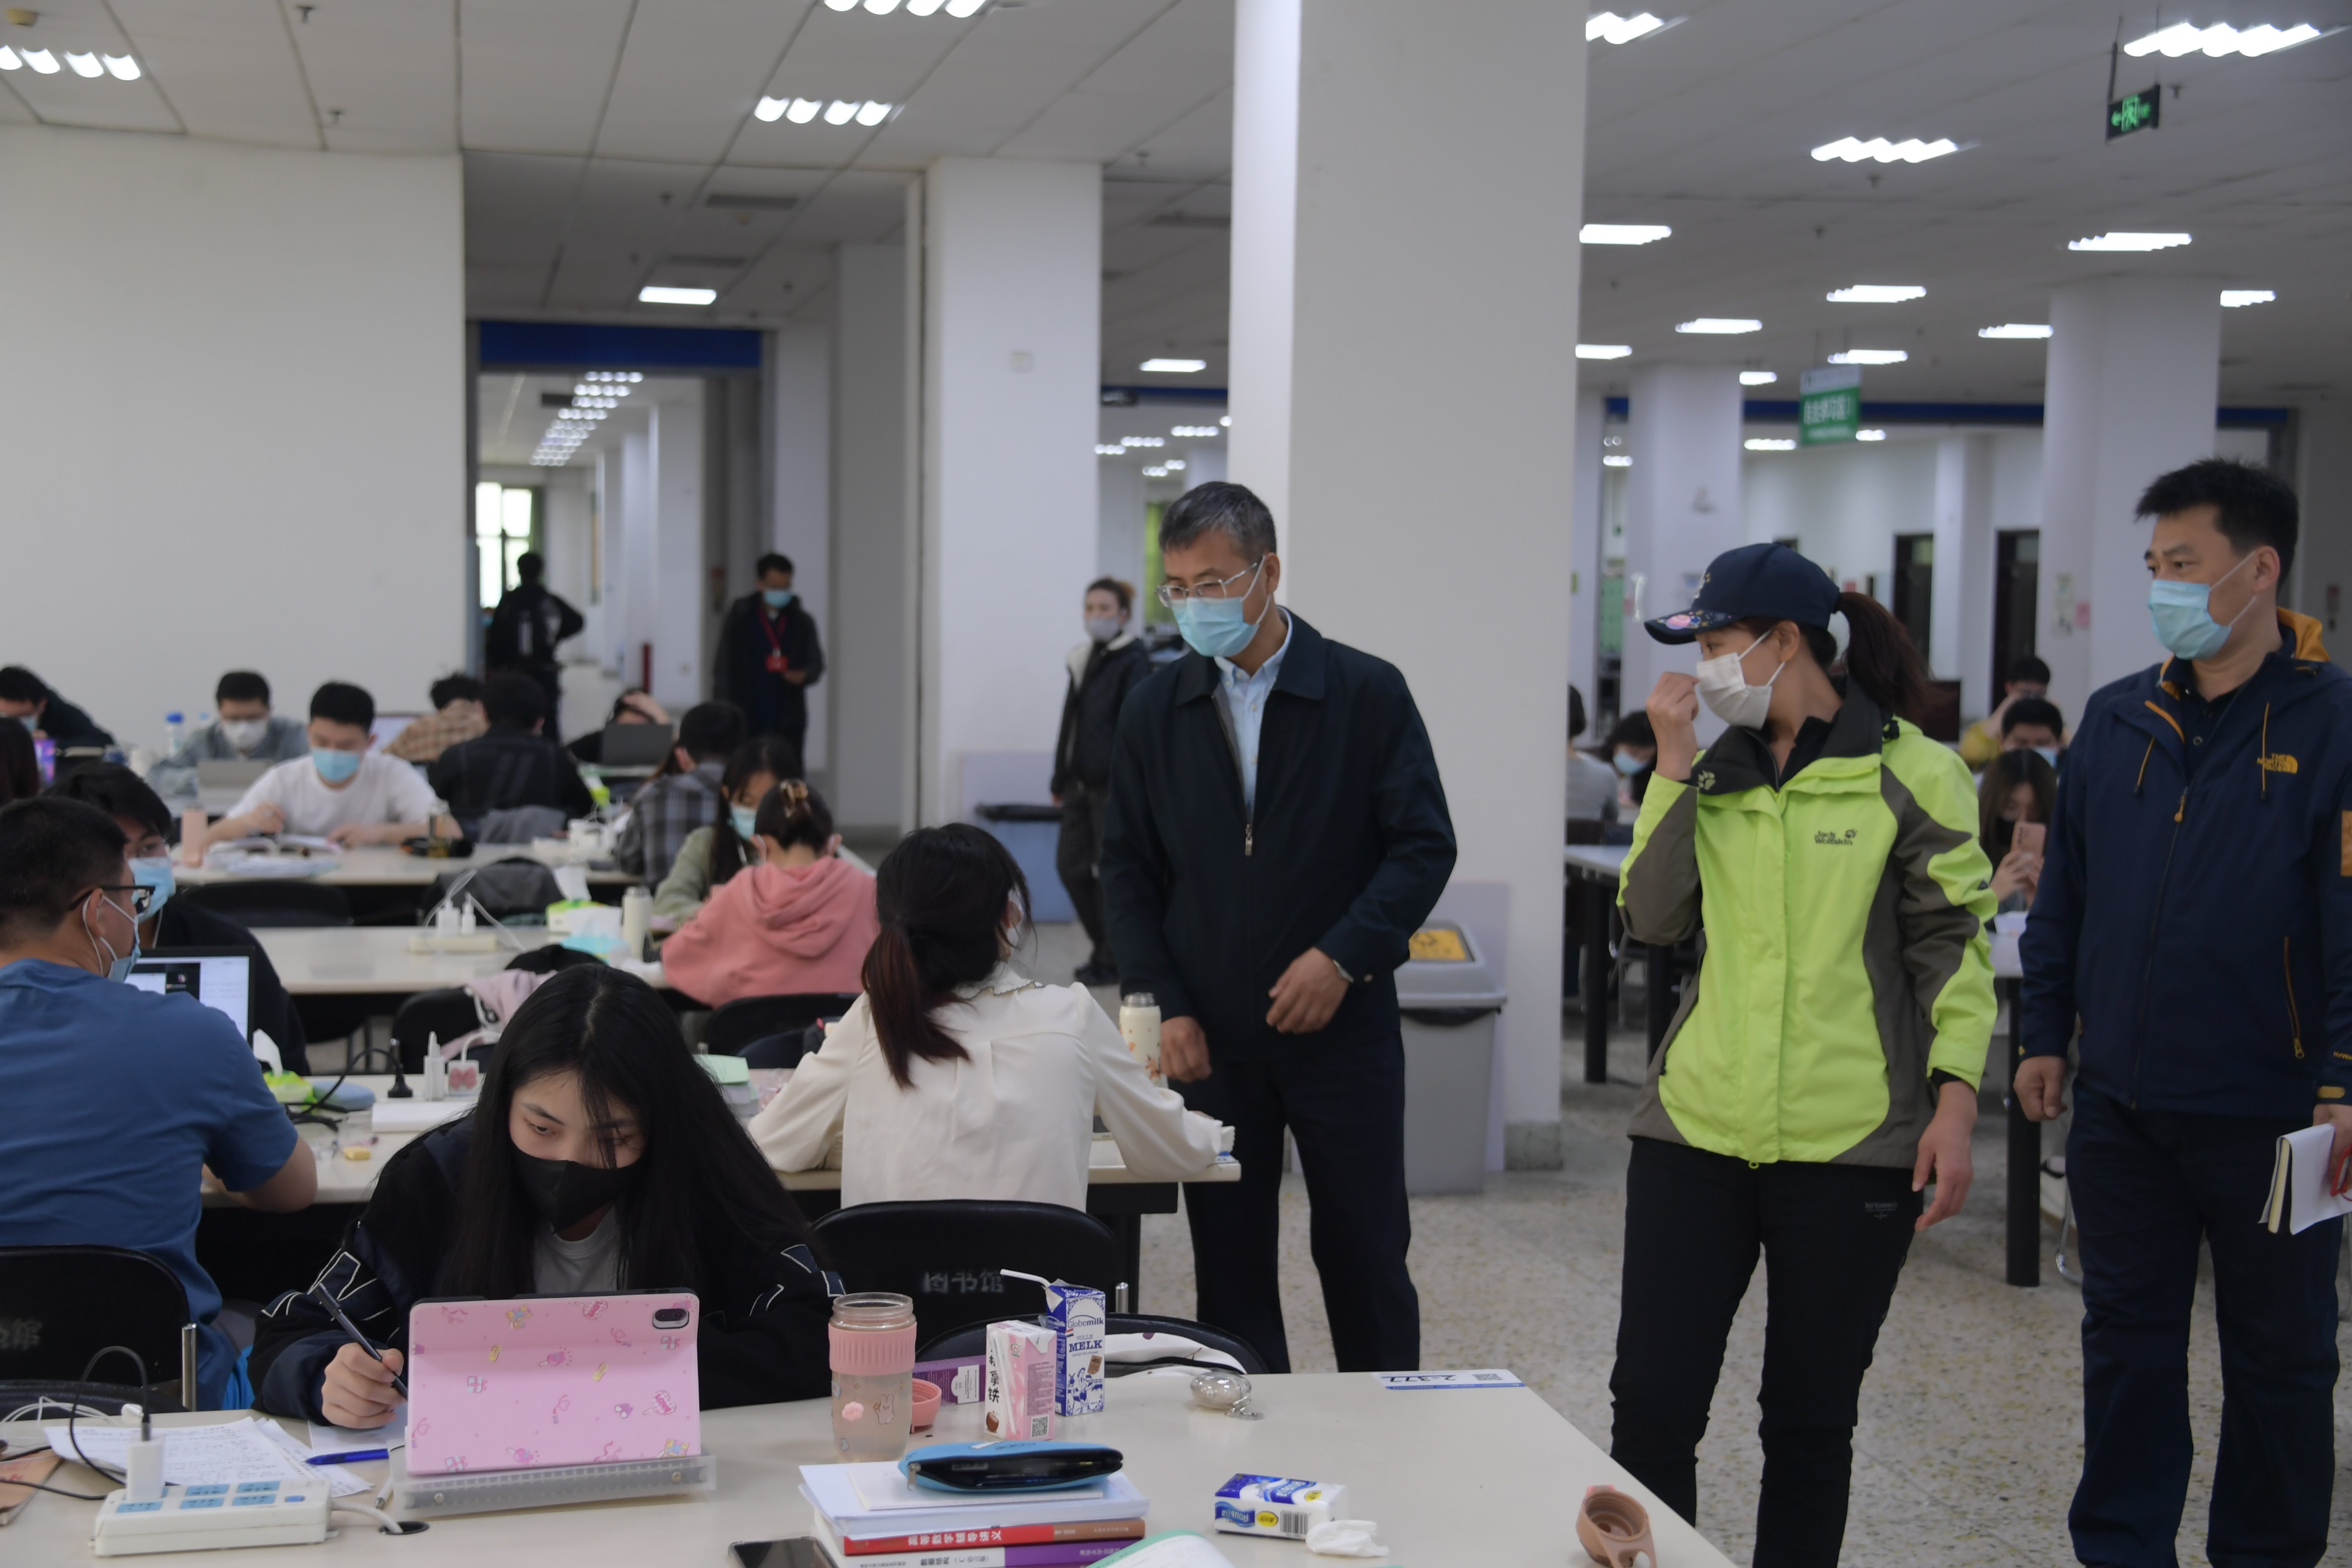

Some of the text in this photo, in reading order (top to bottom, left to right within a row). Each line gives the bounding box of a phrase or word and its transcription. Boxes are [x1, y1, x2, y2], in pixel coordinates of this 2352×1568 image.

[1815, 834, 1853, 845] Wolfskin
[1818, 830, 1835, 838] Jack
[924, 1269, 1004, 1293] 图书馆
[1068, 1317, 1104, 1328] Globemilk
[1069, 1339, 1103, 1352] MELK
[655, 1394, 672, 1413] LOVE
[908, 1530, 1002, 1546] 高等数学辅导讲义
